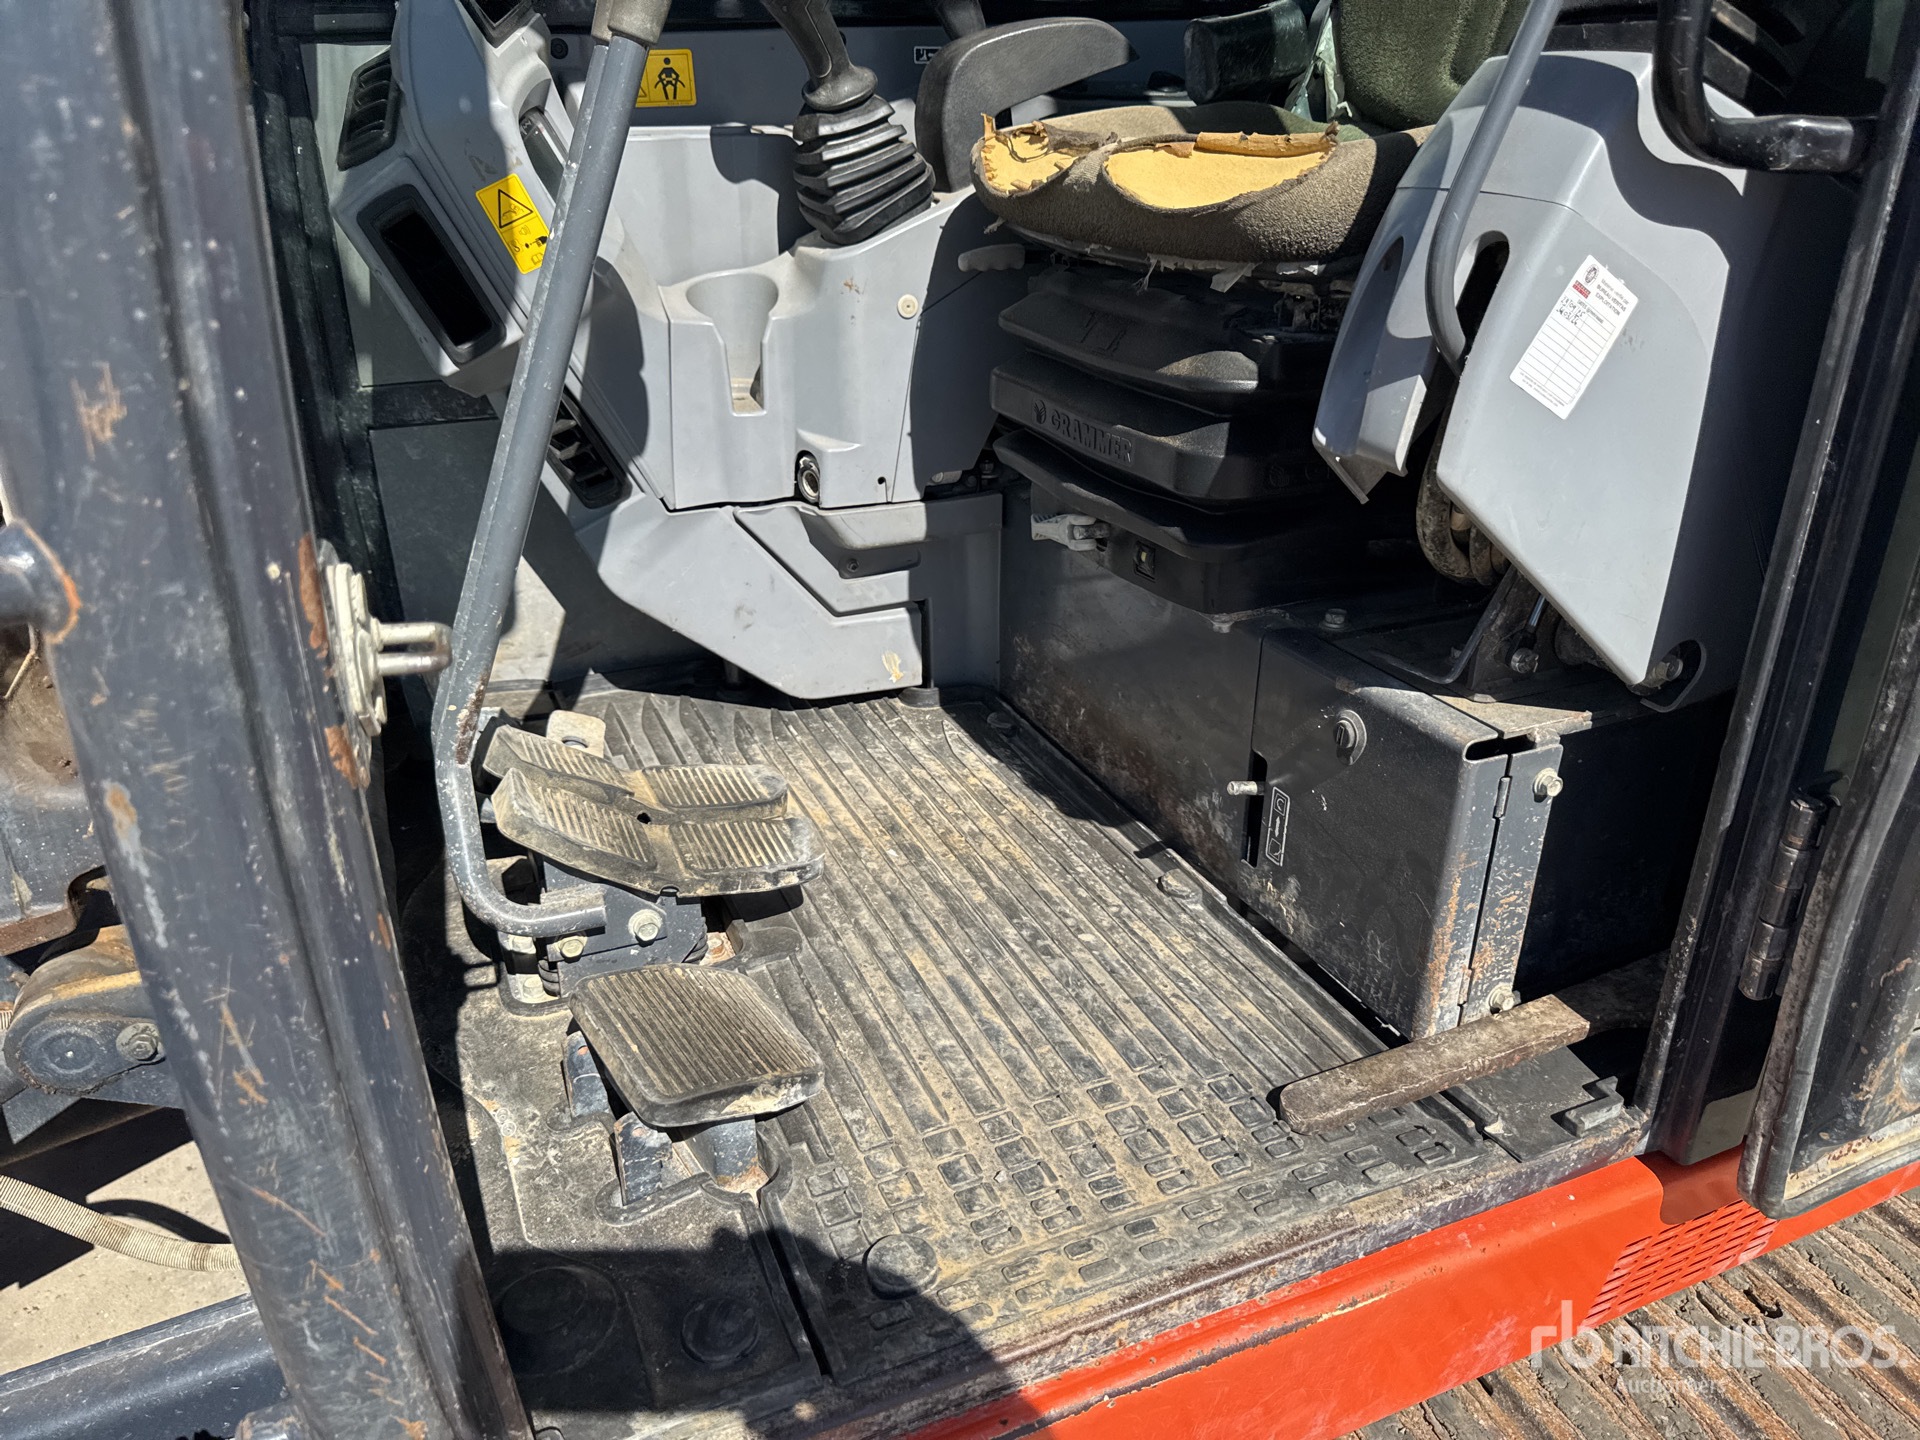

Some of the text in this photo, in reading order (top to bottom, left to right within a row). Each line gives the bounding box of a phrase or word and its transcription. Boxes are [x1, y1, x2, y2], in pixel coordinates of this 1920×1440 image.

[1595, 292, 1621, 316] EXPLOITATION
[1596, 283, 1612, 300] BUREAU
[1610, 296, 1627, 313] VERITAS
[1051, 410, 1133, 463] GRAMMER
